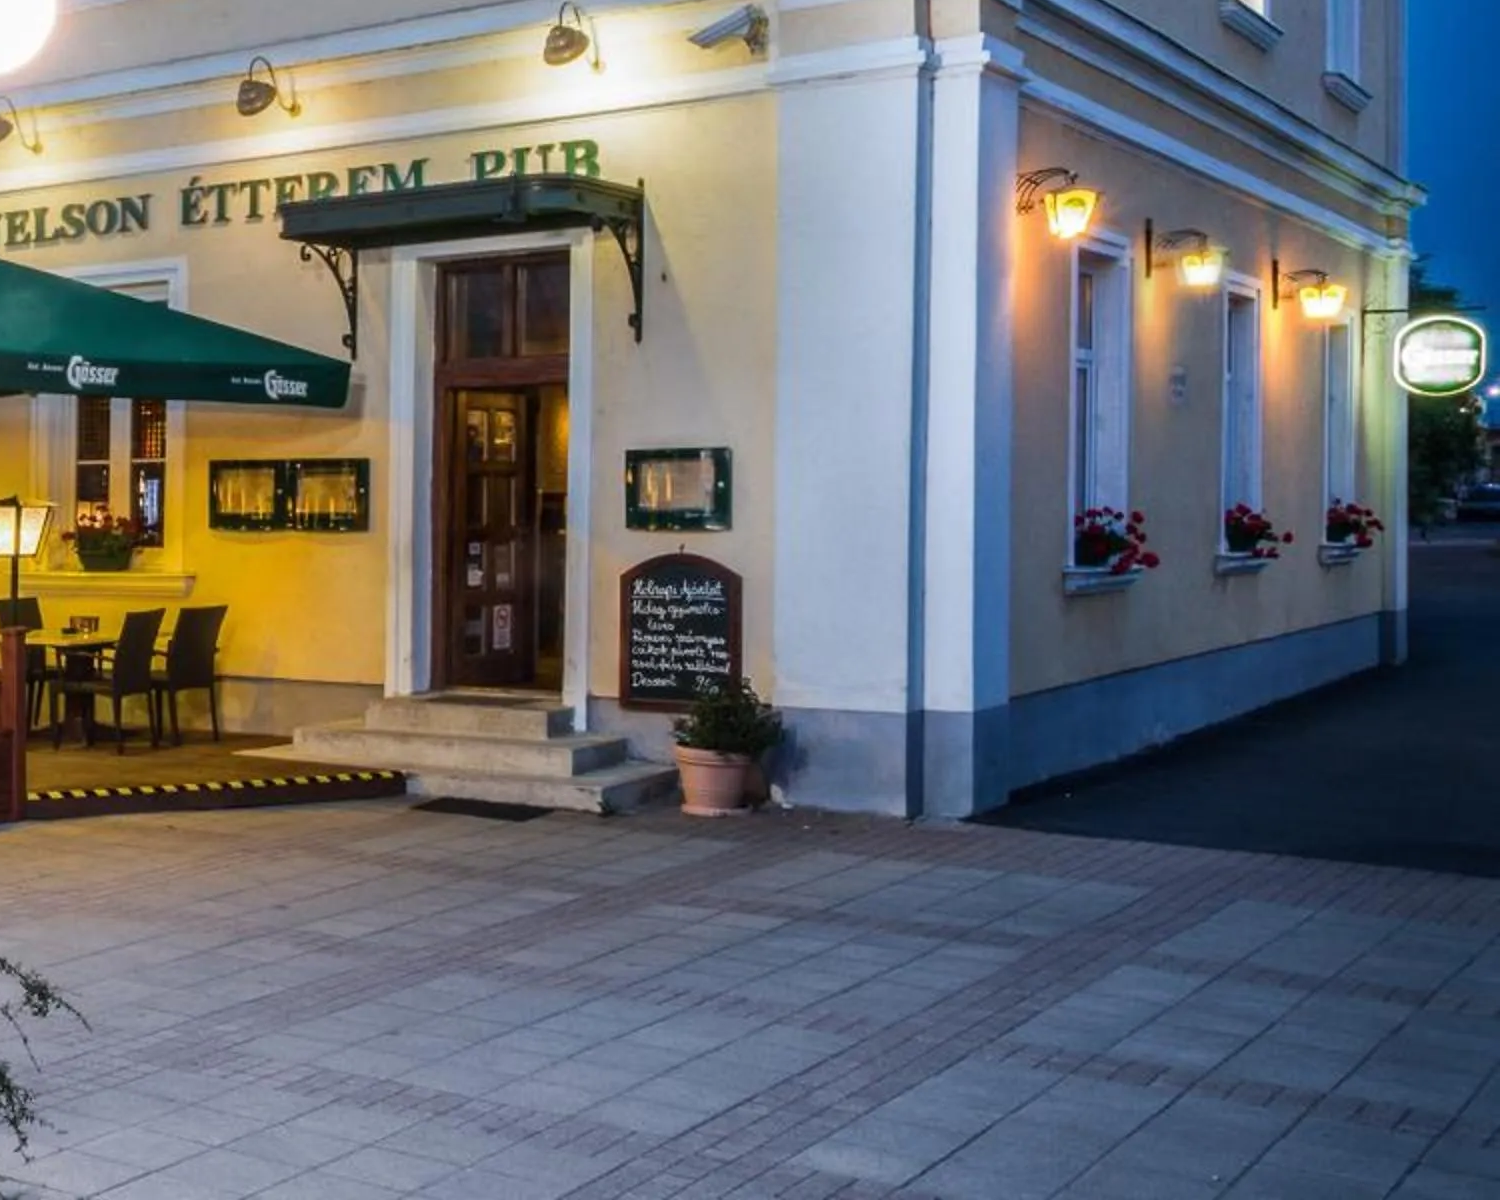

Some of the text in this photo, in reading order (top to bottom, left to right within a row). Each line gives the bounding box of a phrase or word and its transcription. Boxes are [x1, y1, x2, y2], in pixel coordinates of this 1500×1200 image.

[468, 139, 600, 181] PUB
[67, 355, 120, 390] Gösser
[264, 369, 308, 400] Gösser
